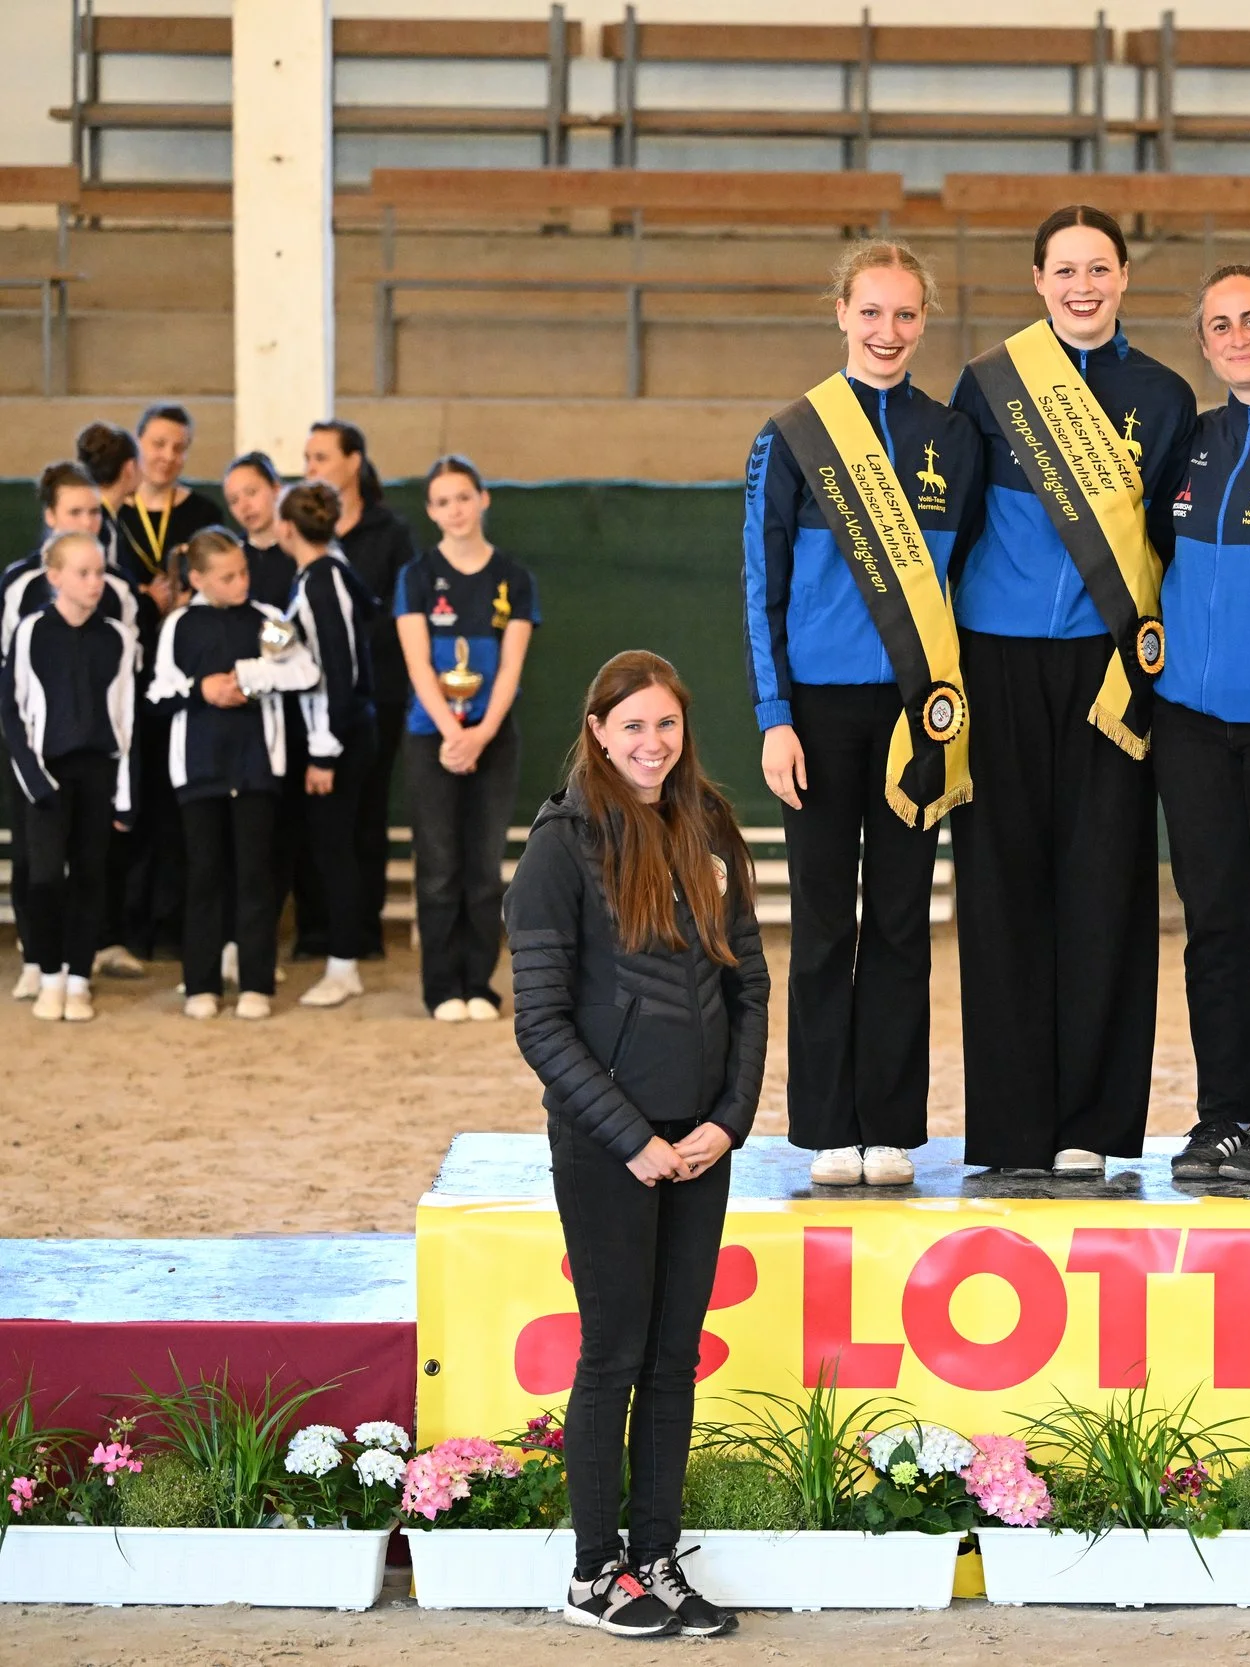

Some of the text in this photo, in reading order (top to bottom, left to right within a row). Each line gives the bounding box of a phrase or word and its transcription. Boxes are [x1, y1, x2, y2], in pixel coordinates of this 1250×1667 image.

[1007, 400, 1080, 521] Doppel-Voltigieren
[1038, 396, 1100, 497] Sachsen-Anhalt
[1052, 384, 1117, 492] Landesmeister
[818, 465, 887, 593] Doppel-Voltigieren
[851, 463, 908, 568] Sachsen-Anhalt
[865, 453, 924, 566] Landesmeister
